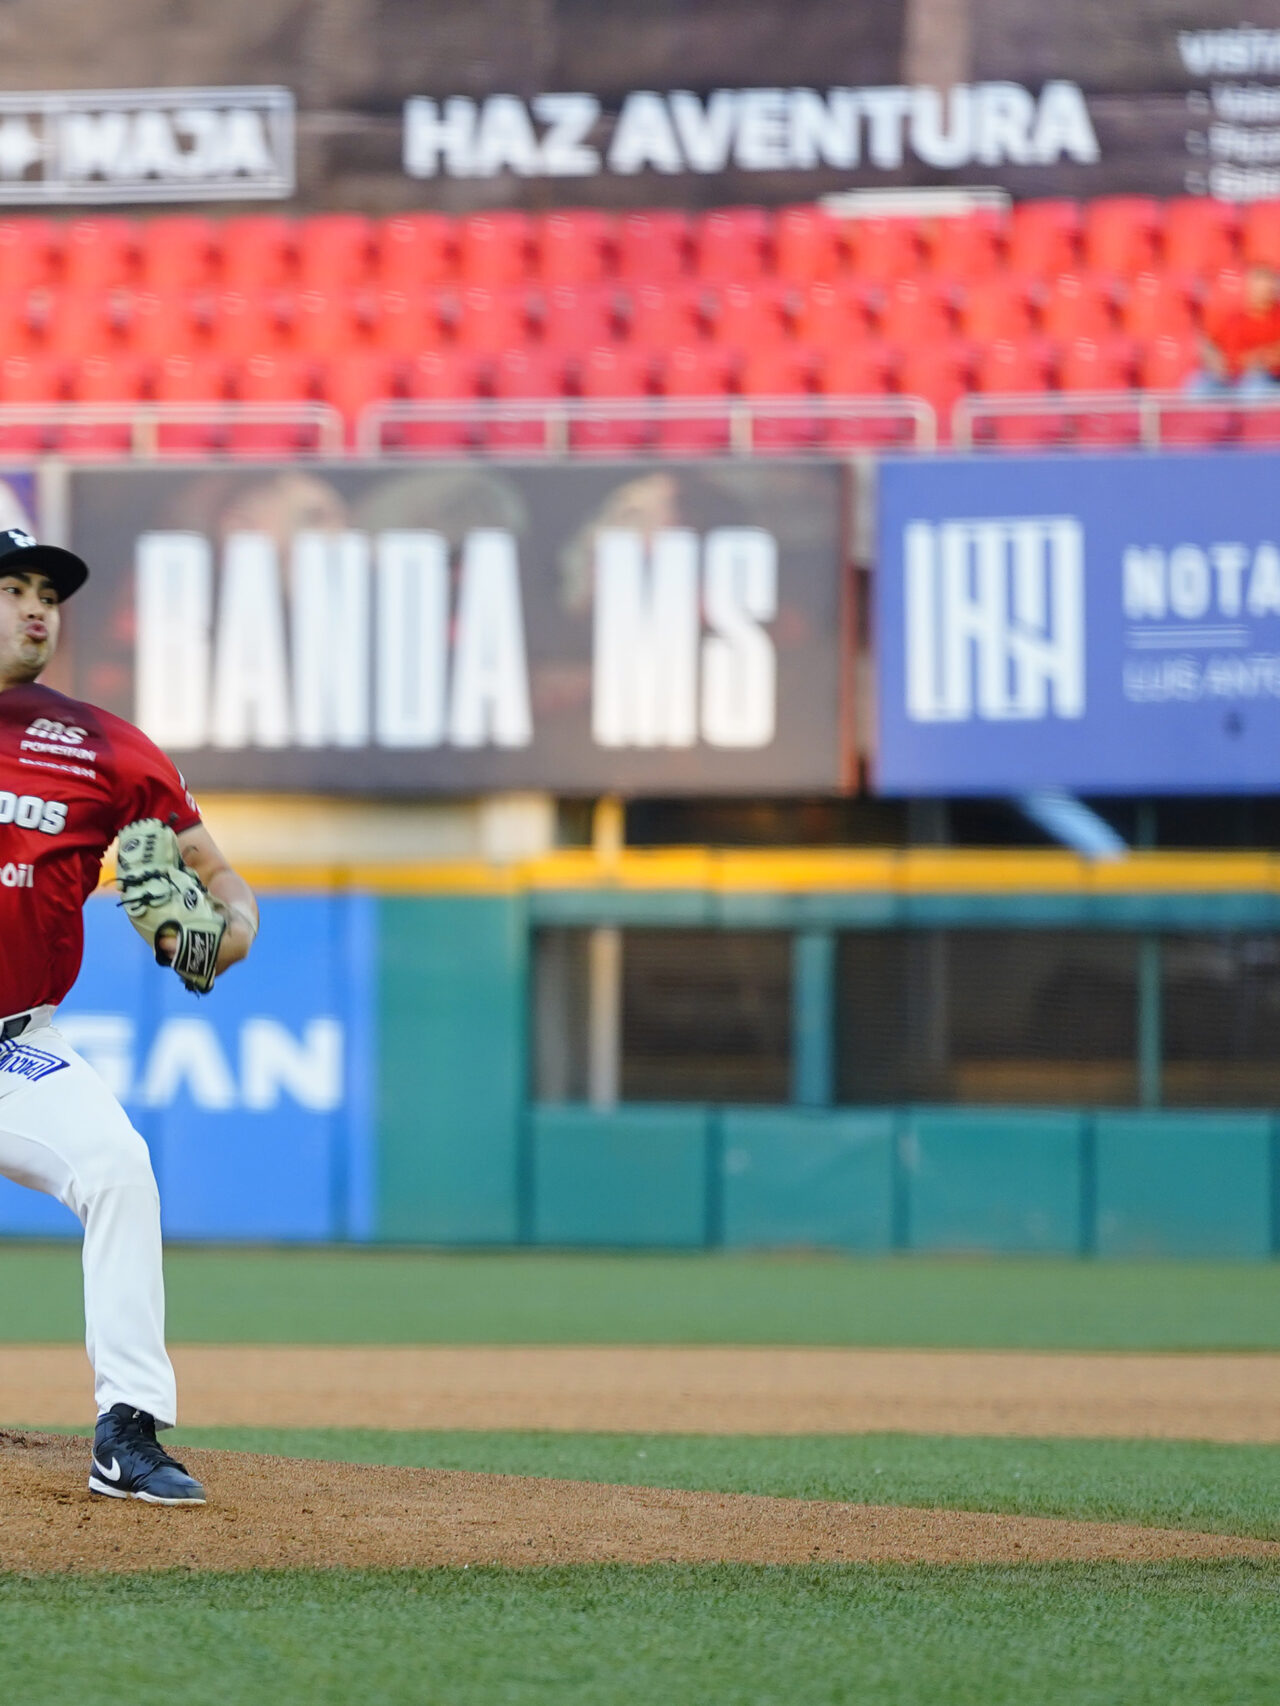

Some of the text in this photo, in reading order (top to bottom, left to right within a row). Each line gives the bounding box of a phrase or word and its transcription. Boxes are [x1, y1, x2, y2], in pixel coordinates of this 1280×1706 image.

[403, 94, 600, 178] HAZ
[608, 80, 1099, 174] AVENTURA
[134, 528, 534, 750] BANDA
[591, 526, 778, 749] MS
